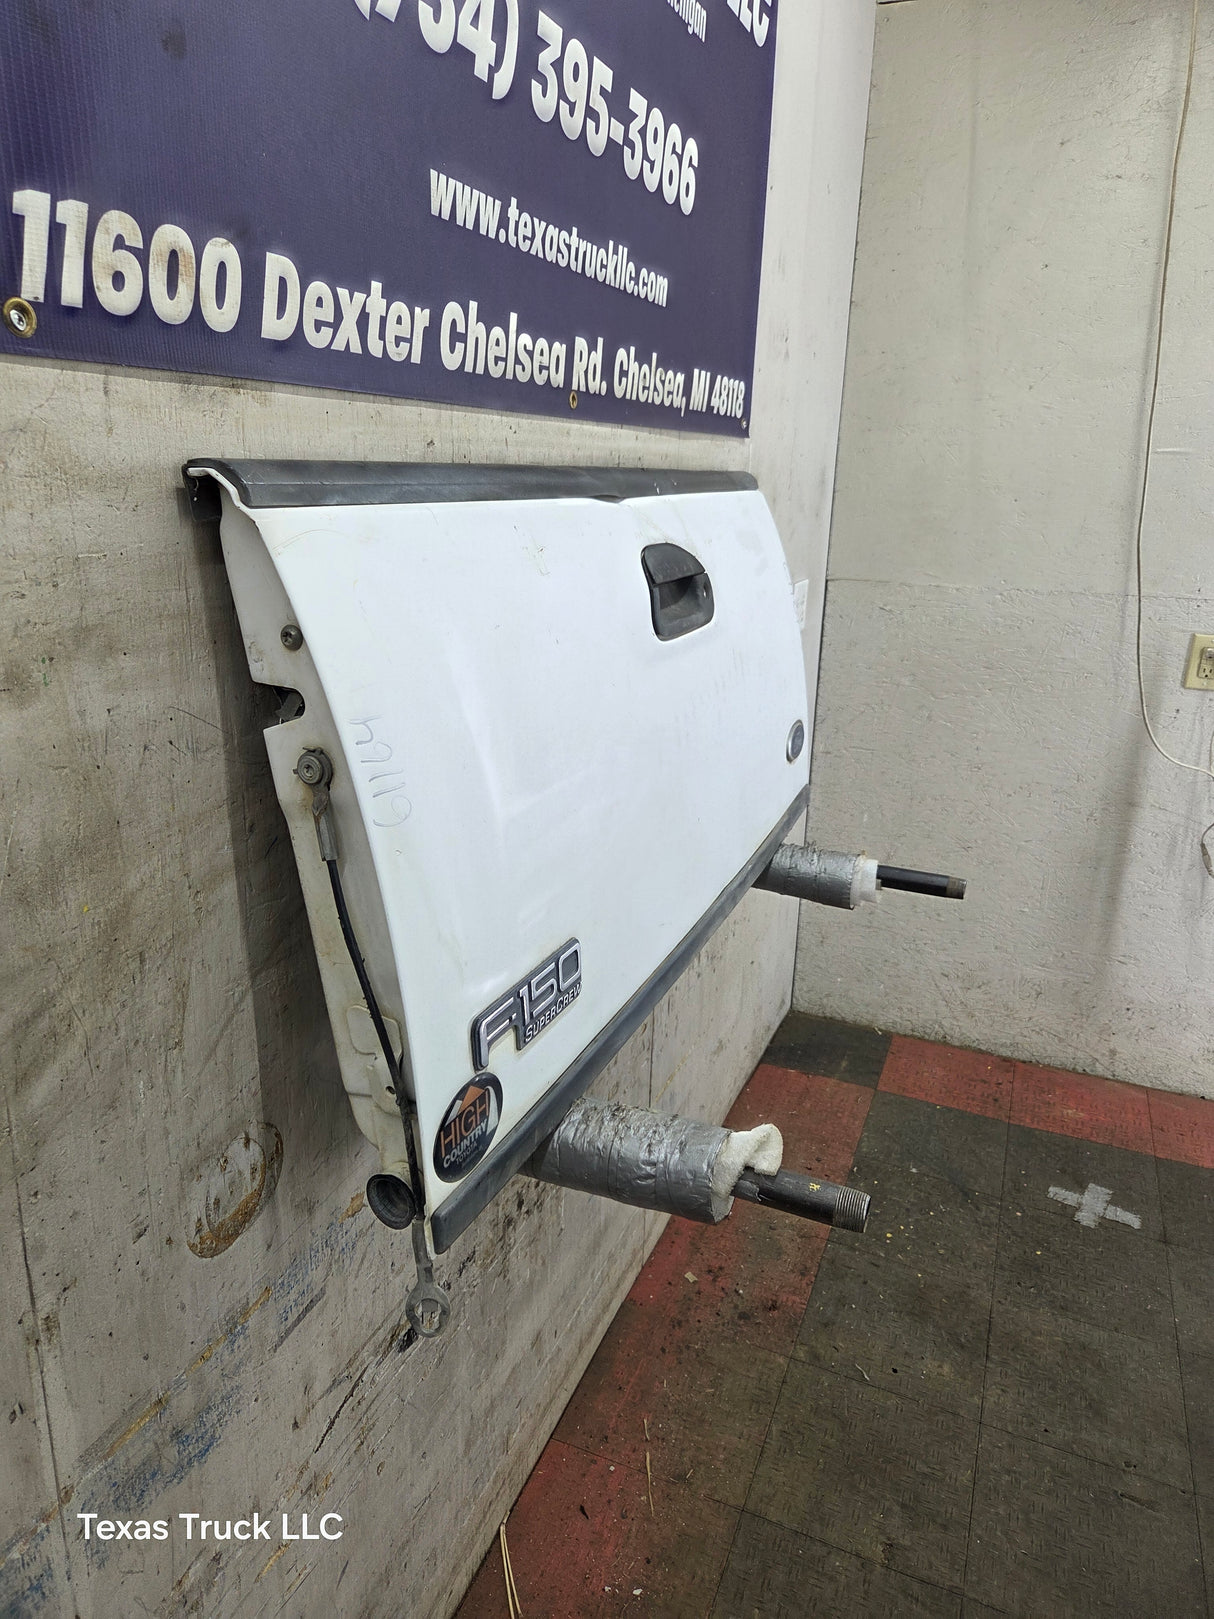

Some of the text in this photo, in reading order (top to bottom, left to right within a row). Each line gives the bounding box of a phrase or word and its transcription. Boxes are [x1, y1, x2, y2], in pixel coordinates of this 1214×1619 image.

[531, 10, 699, 216] 395-3966
[430, 168, 669, 307] www.texastruckllc.com
[12, 189, 746, 419] 11600 Dexter Chelsea Rd. Chelsea, MI 48118
[440, 1089, 489, 1158] HIGH
[443, 1118, 488, 1168] COUNTRY
[456, 1142, 478, 1165] TOYOTA
